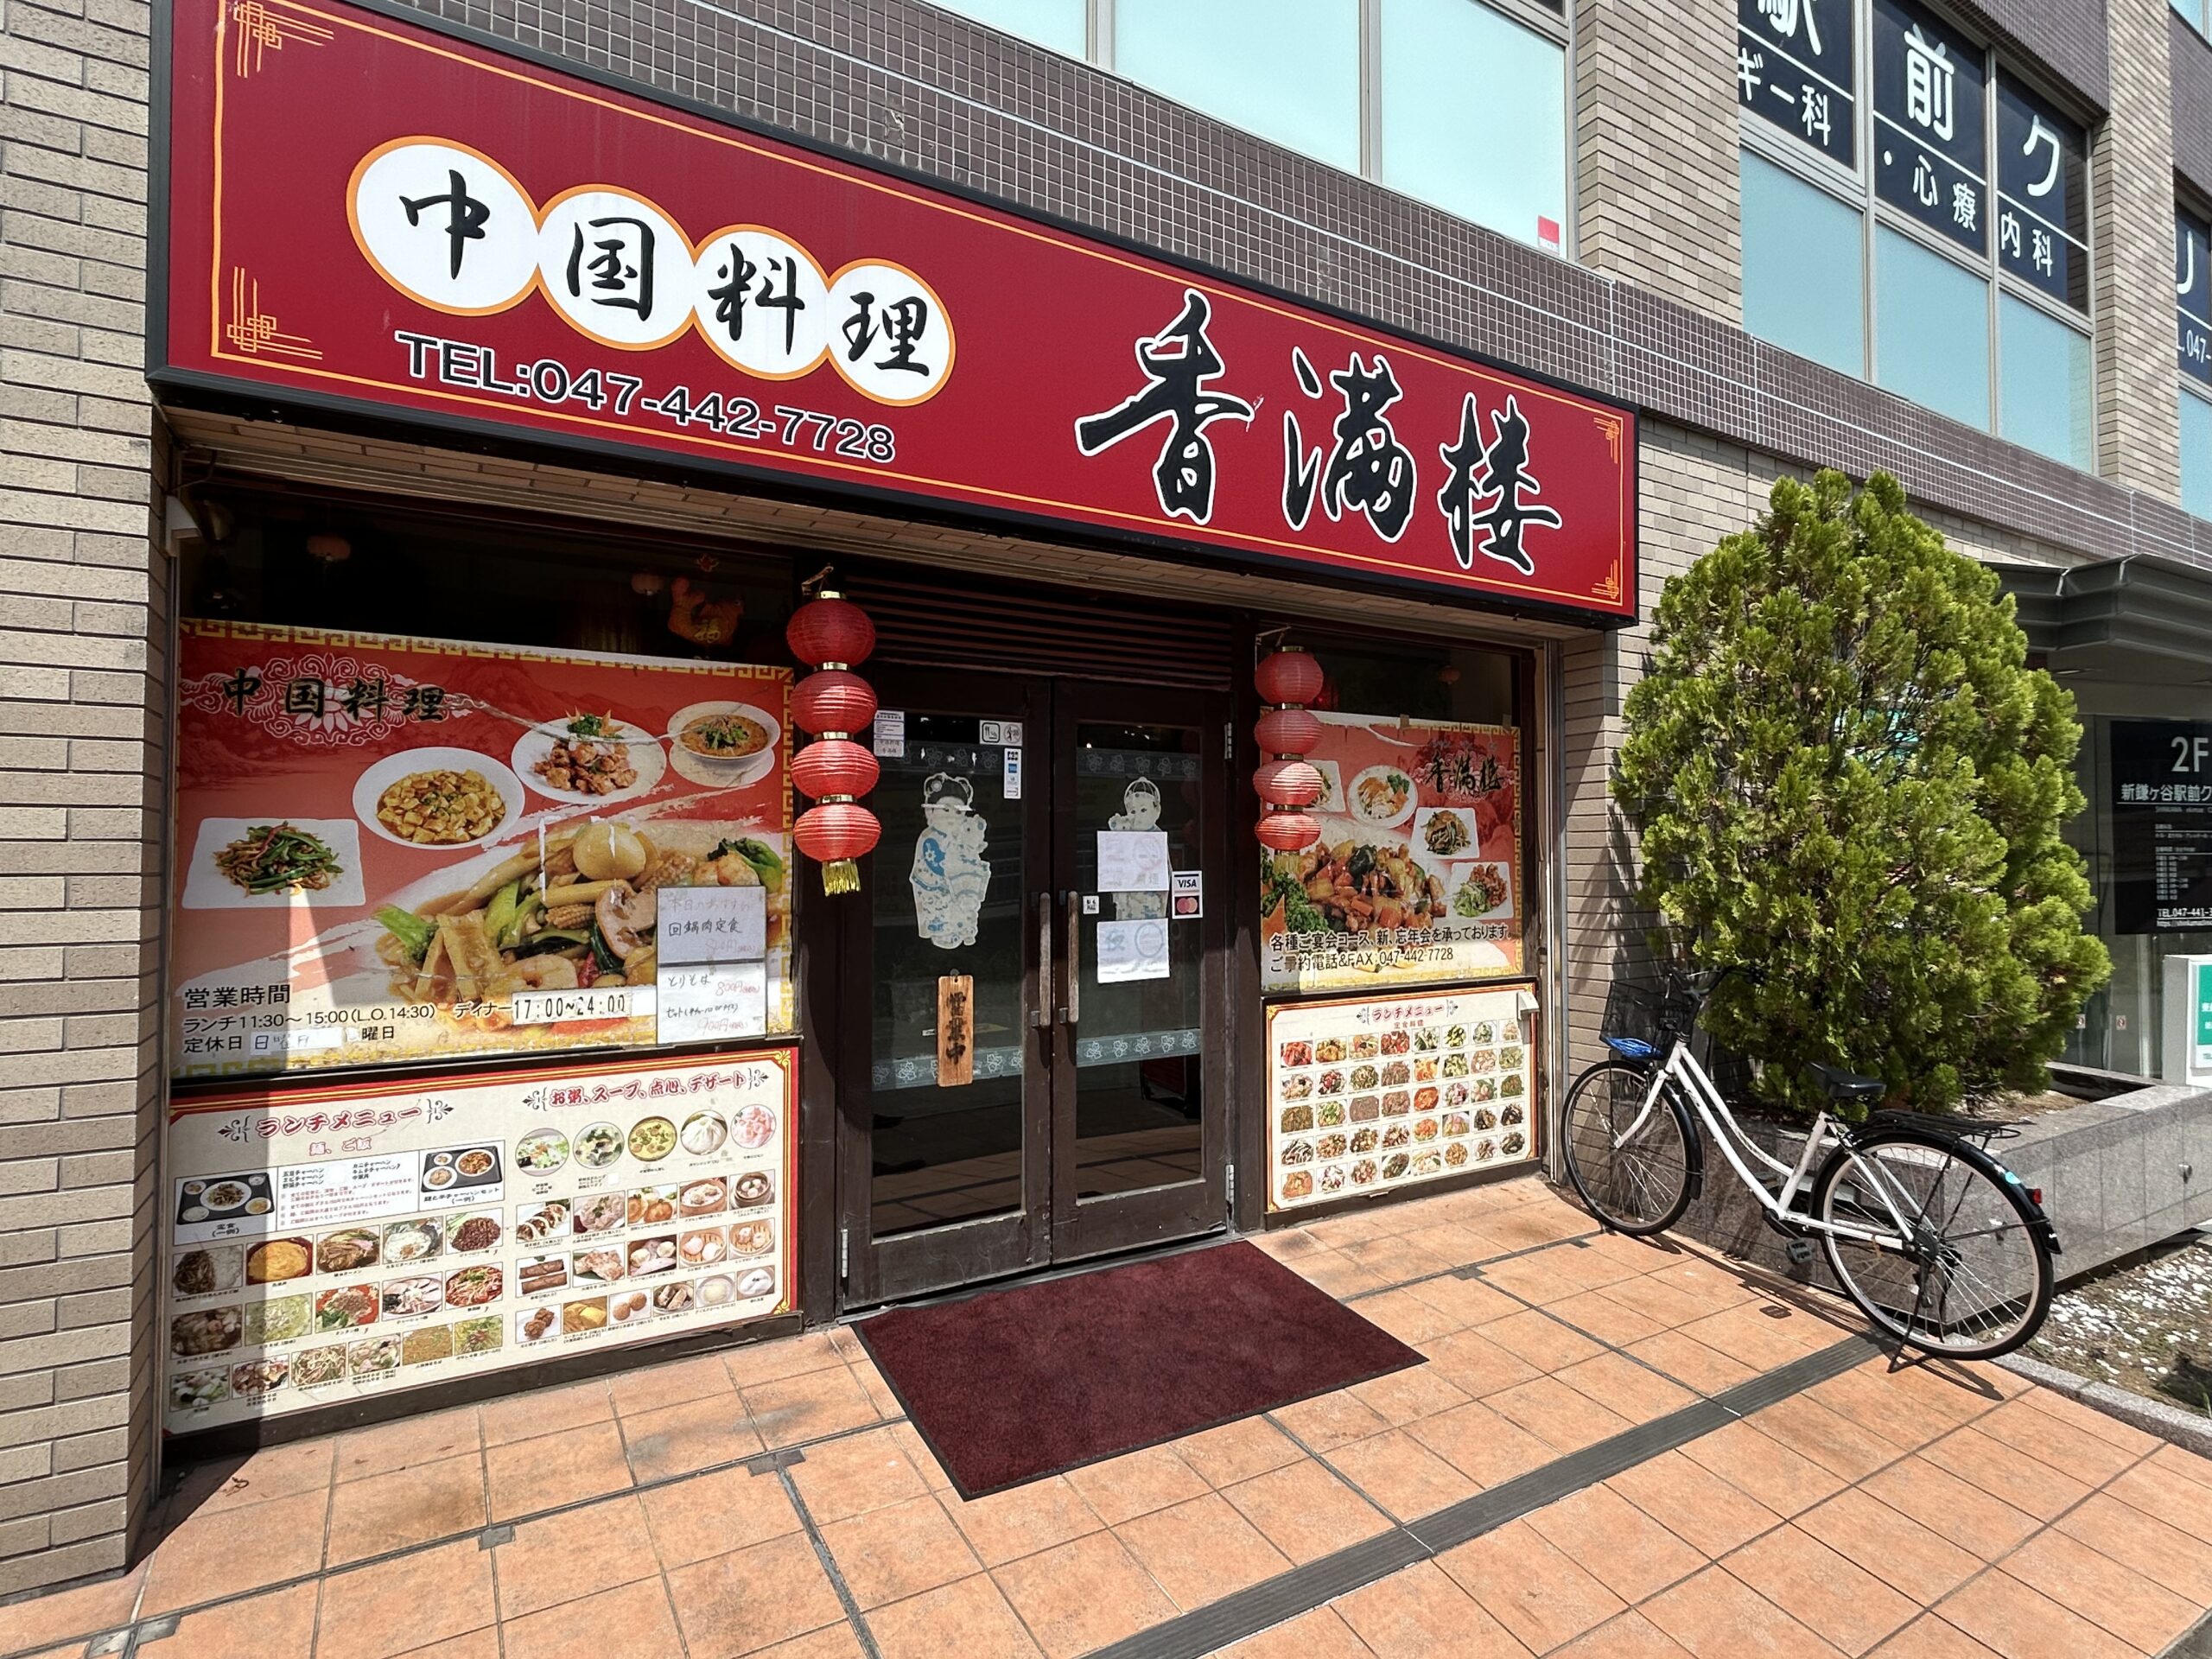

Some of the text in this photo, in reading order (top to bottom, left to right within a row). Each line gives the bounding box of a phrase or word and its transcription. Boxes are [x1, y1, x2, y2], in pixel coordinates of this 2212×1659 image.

[398, 168, 931, 378] 中国料理
[395, 329, 897, 465] TEL:047-442-7728
[1075, 288, 1563, 575] 香満楼
[222, 667, 446, 722] 中国料理
[2171, 737, 2209, 772] 2F
[1427, 751, 1503, 793] 香満楼
[1178, 879, 1197, 888] VISA
[669, 917, 742, 937] 回鍋肉定食
[184, 984, 291, 1010] 営業時間
[454, 1002, 512, 1019] ディナー
[1372, 1005, 1445, 1022] ランチメニュー
[184, 1035, 243, 1054] 定休日
[361, 1026, 395, 1041] 曜日
[550, 1071, 747, 1108] お粥、スープ、点心、デザート
[256, 1106, 422, 1139] ランチメニュー
